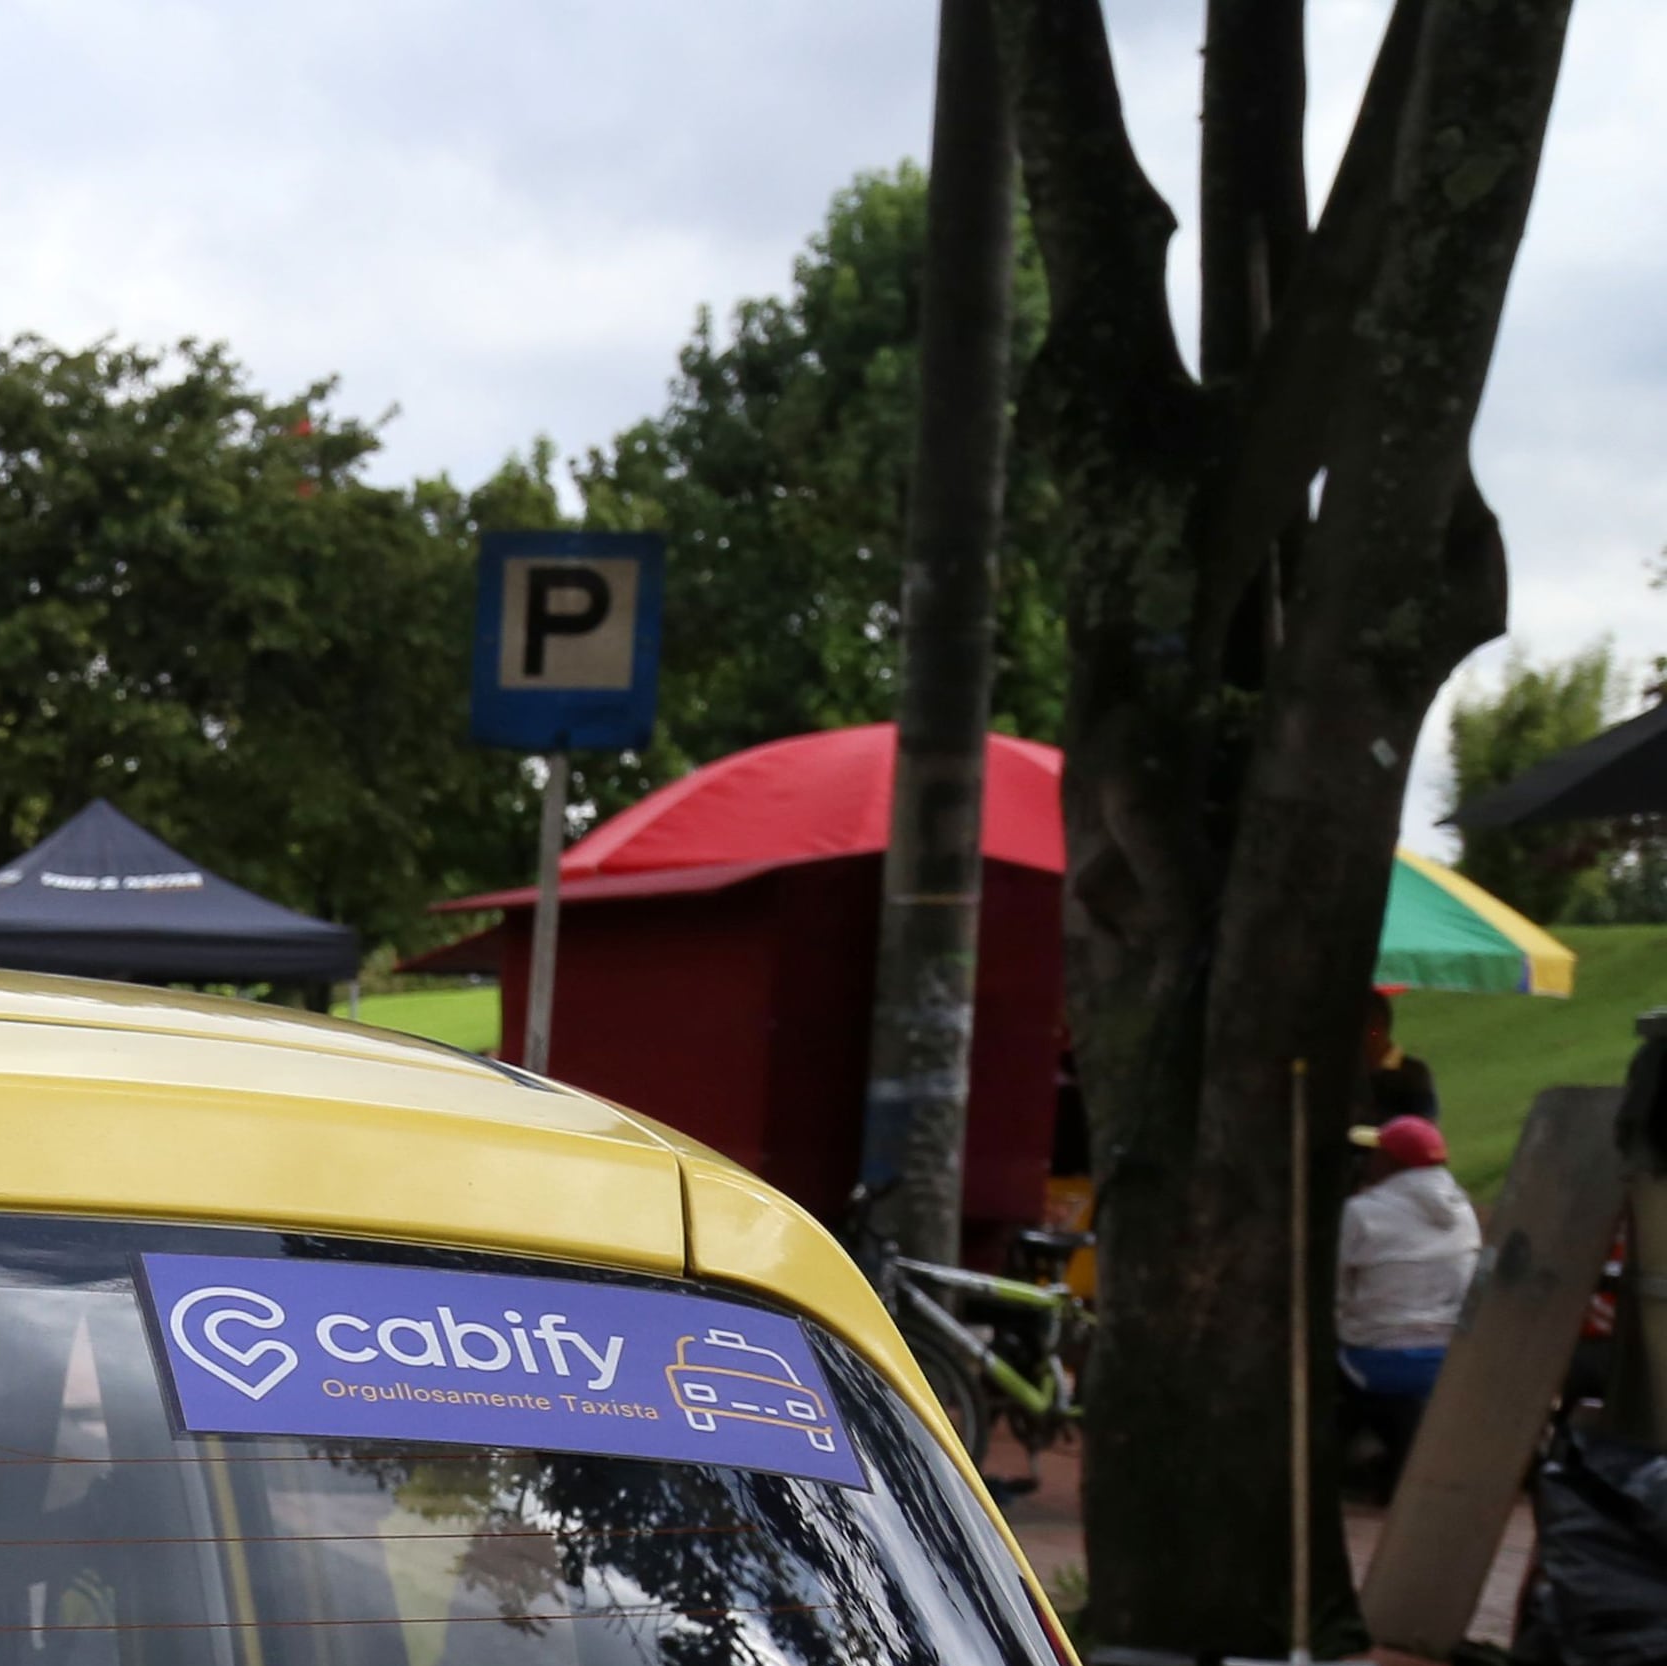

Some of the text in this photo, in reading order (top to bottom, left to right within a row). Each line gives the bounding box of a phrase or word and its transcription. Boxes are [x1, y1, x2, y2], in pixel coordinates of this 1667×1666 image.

[523, 567, 611, 676] P
[315, 1307, 624, 1391] cabify
[321, 1377, 659, 1422] Orgullosamente Taxista
